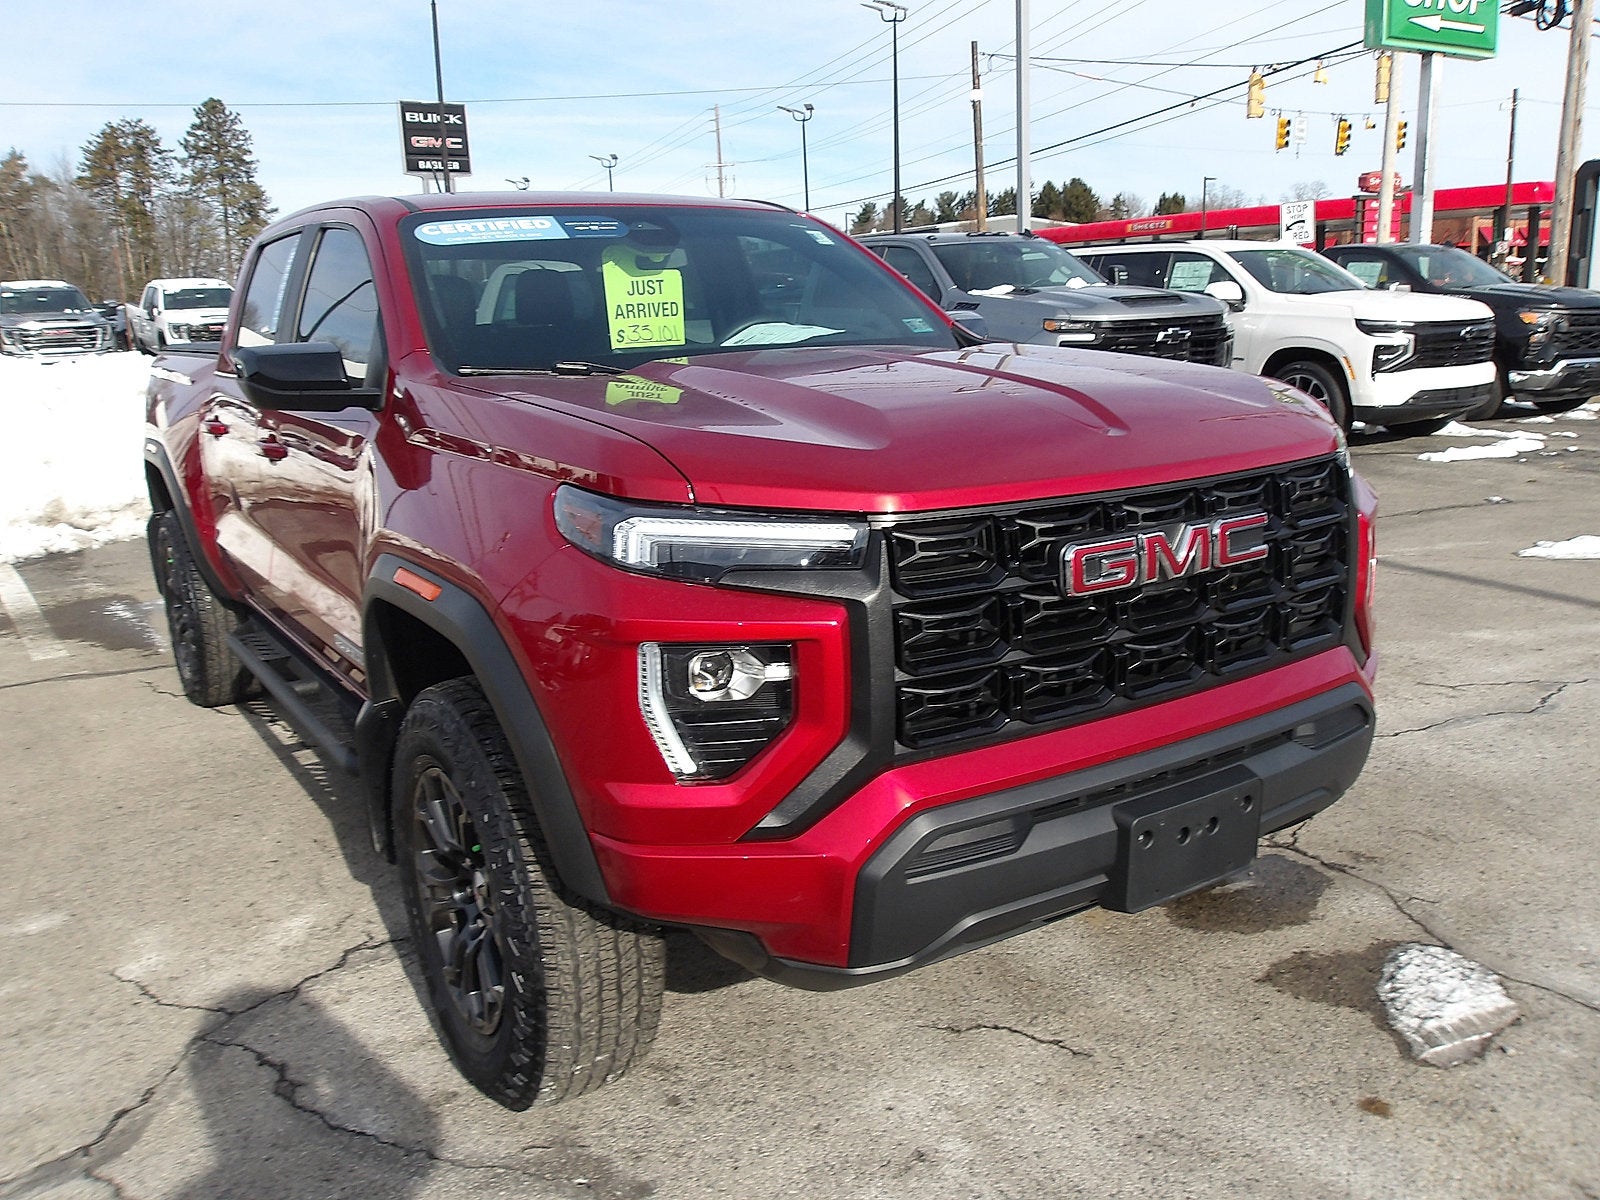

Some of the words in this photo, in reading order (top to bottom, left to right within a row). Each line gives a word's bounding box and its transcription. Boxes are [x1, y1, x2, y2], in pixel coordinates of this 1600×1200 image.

[1286, 203, 1309, 215] STOP
[421, 219, 552, 235] CERTIFIED
[1292, 230, 1310, 240] RED
[627, 279, 664, 296] JUST
[615, 302, 679, 320] ARRIVED
[1061, 512, 1269, 597] GMC
